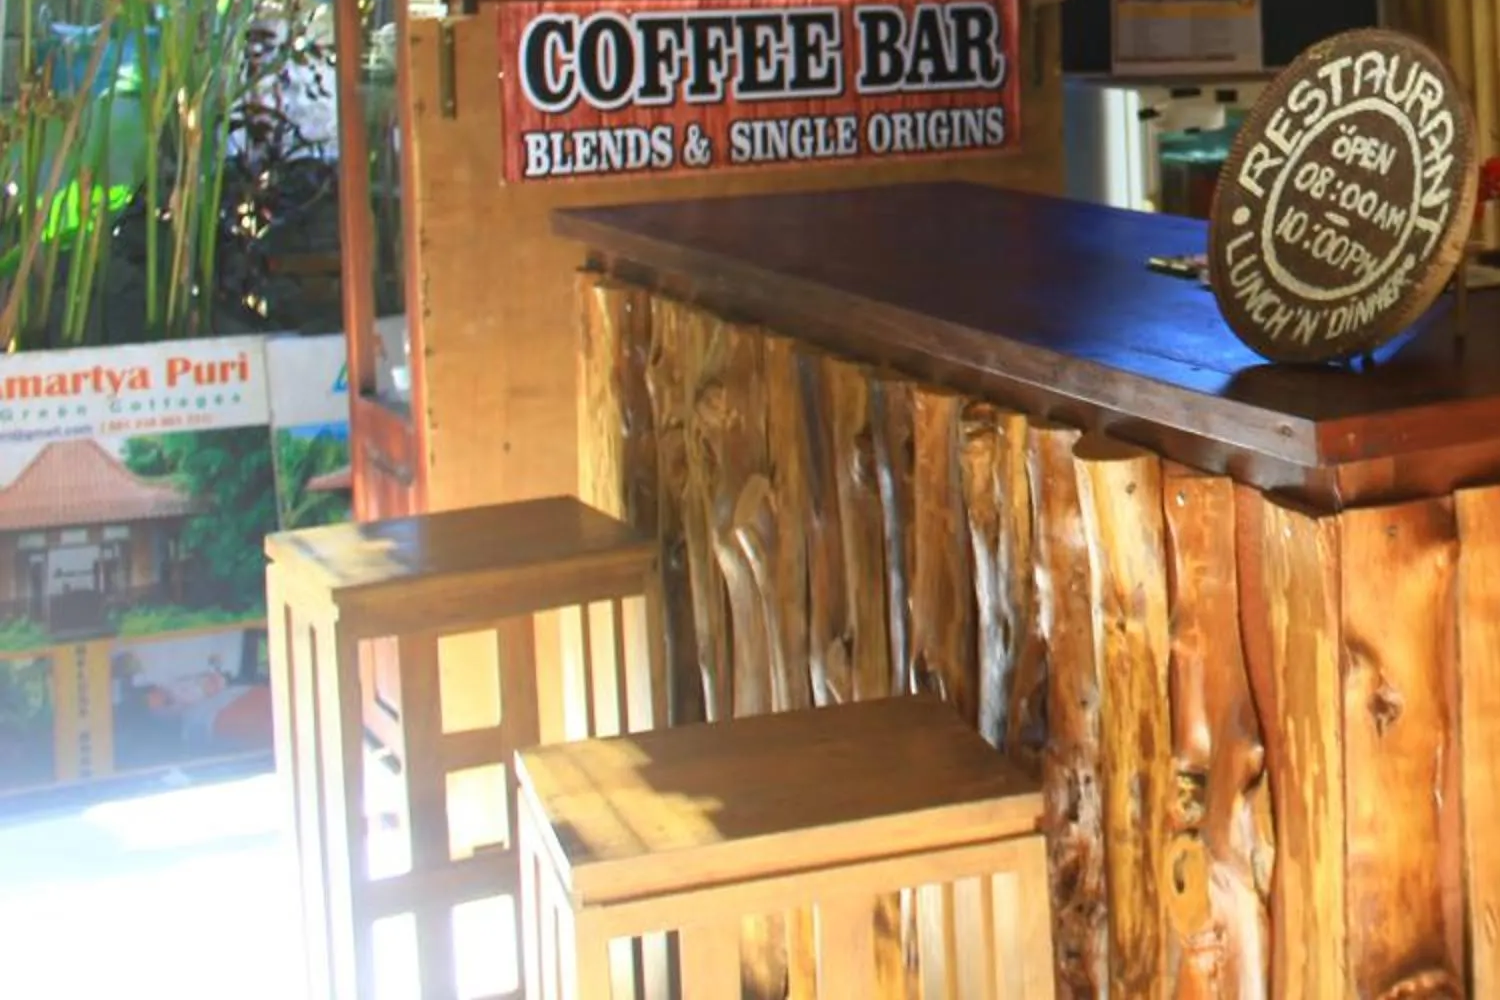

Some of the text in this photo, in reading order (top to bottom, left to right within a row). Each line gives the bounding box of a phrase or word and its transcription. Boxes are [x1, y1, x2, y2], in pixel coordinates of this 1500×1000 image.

[519, 8, 845, 111] COFFEE
[855, 0, 1004, 94] BAR
[524, 107, 1005, 177] BLENDS & SINGLE ORIGINS
[1238, 51, 1455, 261] RESTAURANT
[0, 352, 250, 401] martya Puri
